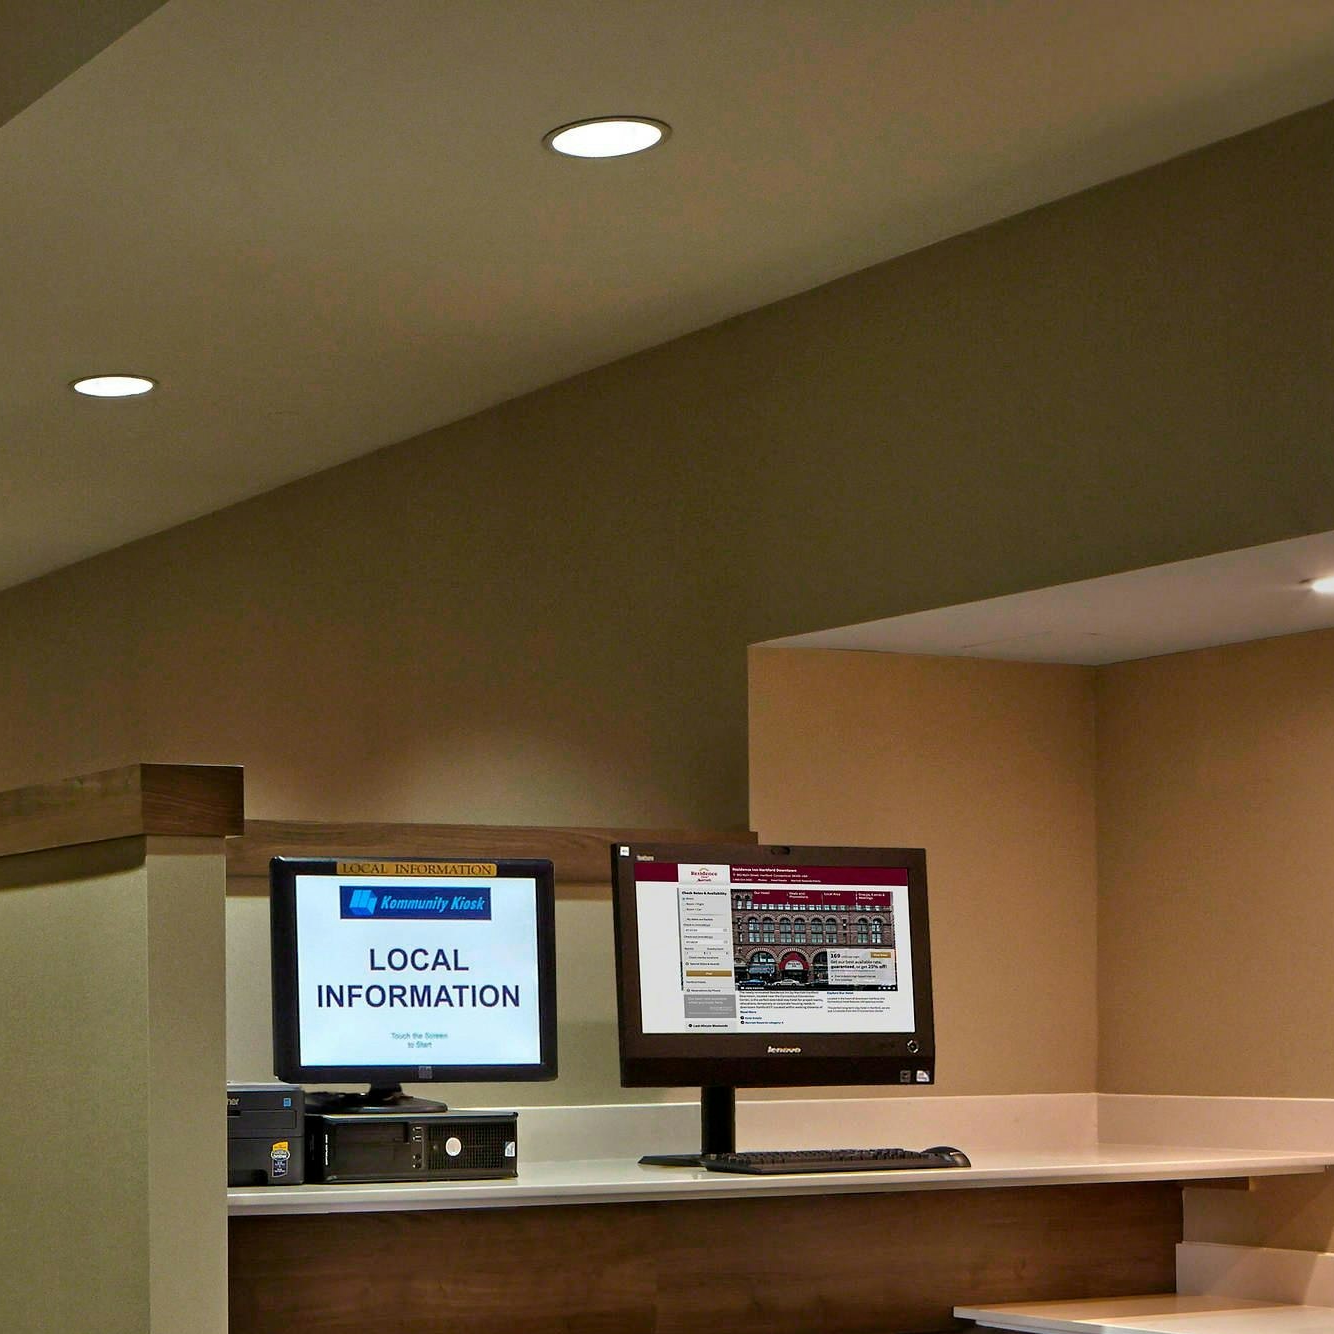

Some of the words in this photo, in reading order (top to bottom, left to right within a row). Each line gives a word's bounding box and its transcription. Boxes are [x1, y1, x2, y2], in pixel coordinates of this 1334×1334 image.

[342, 863, 388, 874] LOCAL
[395, 864, 492, 875] INFORMATION
[381, 895, 449, 913] Kommunity
[450, 896, 485, 910] Kiosk
[370, 948, 469, 972] LOCAL
[317, 984, 520, 1008] INFORMATION
[391, 1032, 410, 1040] Touch
